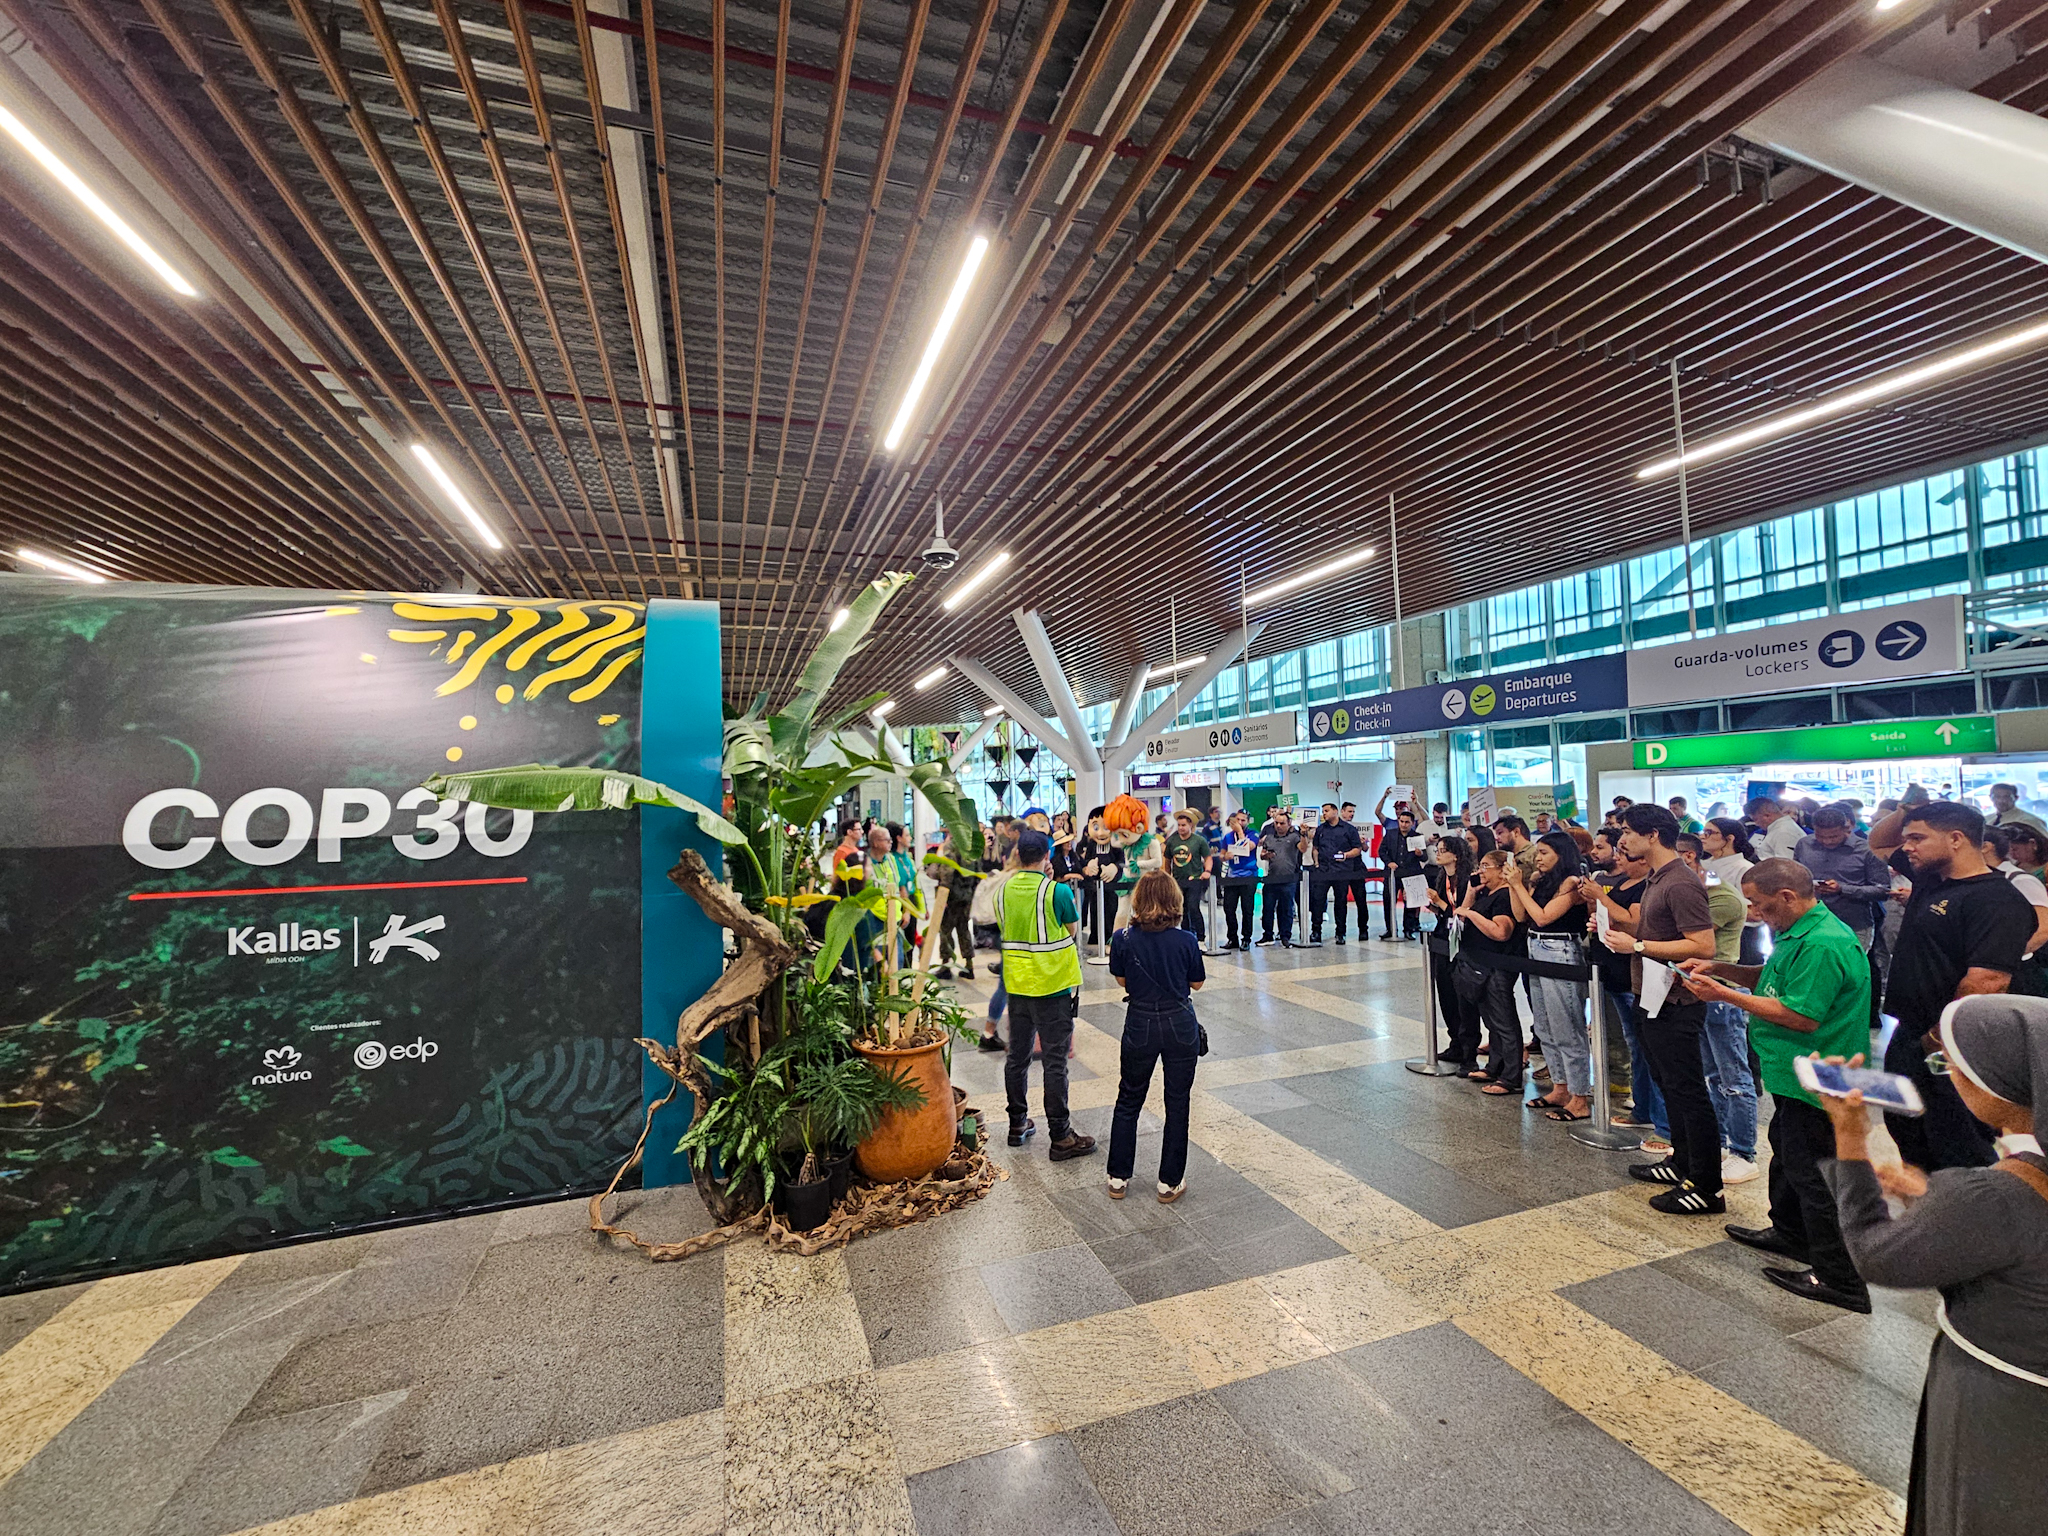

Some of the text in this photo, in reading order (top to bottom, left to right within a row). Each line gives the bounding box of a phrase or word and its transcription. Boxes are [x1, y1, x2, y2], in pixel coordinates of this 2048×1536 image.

[1674, 639, 1808, 668] Guarda-volumes
[1745, 659, 1809, 677] Lockers
[1504, 672, 1572, 692] Embarque
[1505, 690, 1577, 711] Departures
[1354, 702, 1392, 717] Check-in
[1354, 717, 1391, 731] Check-in
[1244, 733, 1269, 743] Restrooms
[1870, 729, 1906, 741] Saída
[1645, 743, 1668, 765] D
[1886, 743, 1907, 753] Exit
[122, 787, 534, 869] COP30
[227, 922, 341, 956] Kallas
[288, 955, 305, 963] OOH
[310, 1019, 382, 1032] Clientes realizadores:
[389, 1036, 439, 1063] edp
[252, 1069, 313, 1086] natura
